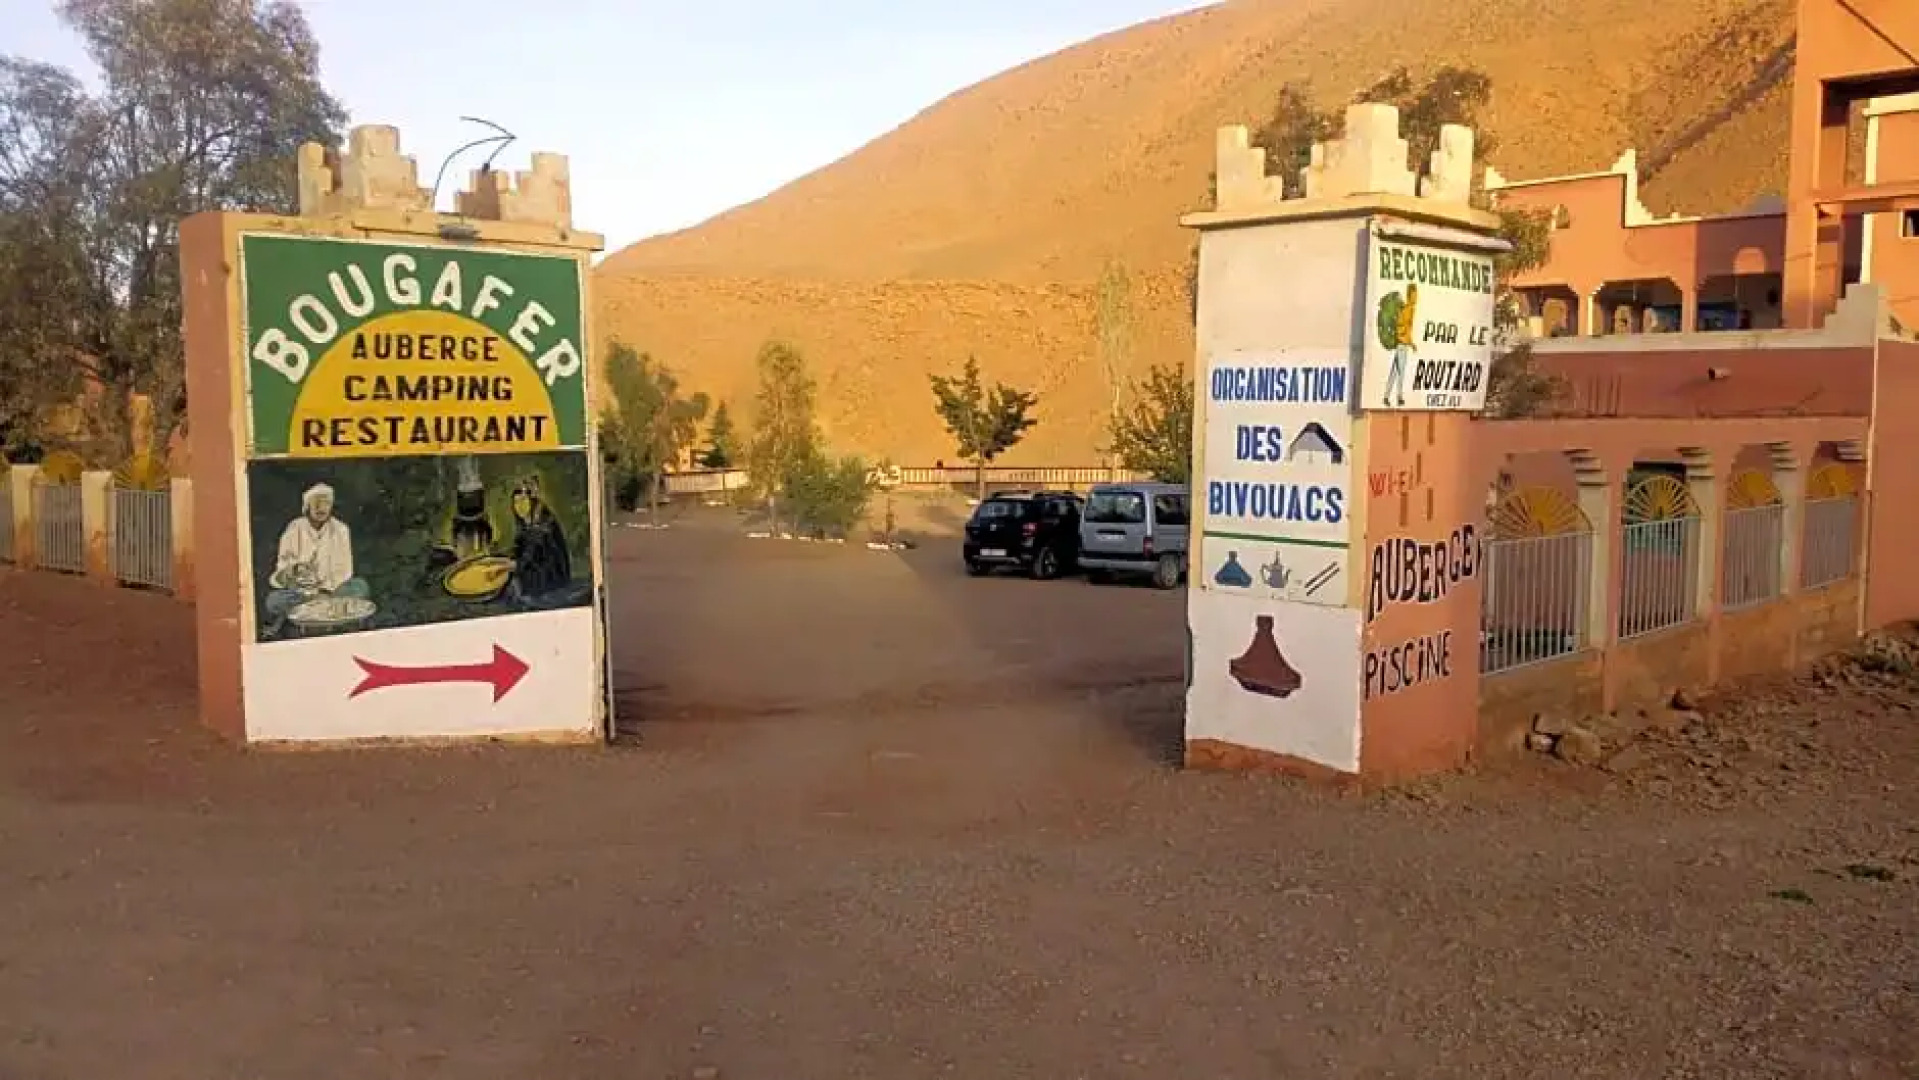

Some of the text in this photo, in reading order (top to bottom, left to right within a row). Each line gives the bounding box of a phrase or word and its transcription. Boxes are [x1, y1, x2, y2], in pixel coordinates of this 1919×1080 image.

[1379, 247, 1491, 294] RECOMMANDE
[253, 254, 581, 386] BOUGAFER
[1423, 321, 1489, 345] PAR LE
[352, 333, 499, 361] AUBERGE
[344, 375, 513, 401] CAMPING
[1211, 366, 1347, 403] ORGANISATION
[1413, 359, 1483, 392] ROUTARD
[302, 415, 548, 447] RESTAURANT
[1236, 425, 1281, 462] DES
[1210, 481, 1343, 524] BIVOUACS
